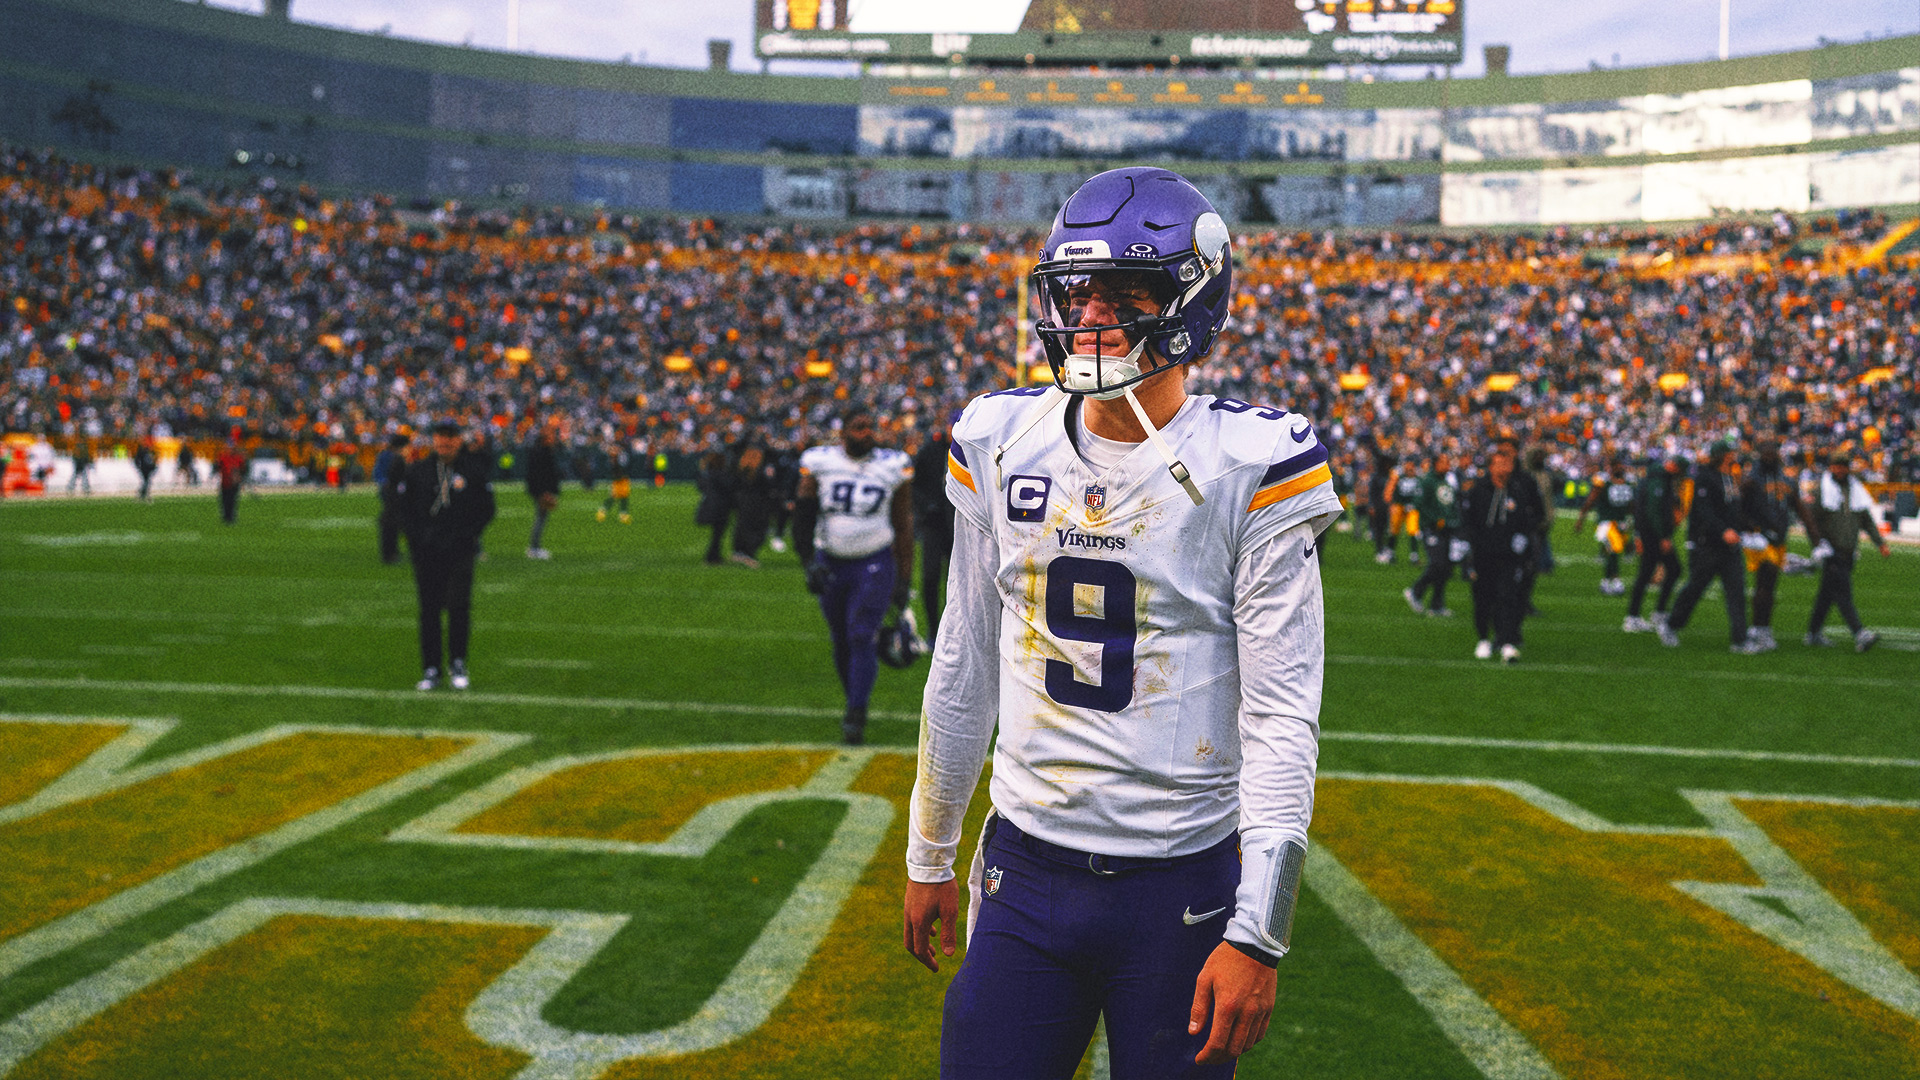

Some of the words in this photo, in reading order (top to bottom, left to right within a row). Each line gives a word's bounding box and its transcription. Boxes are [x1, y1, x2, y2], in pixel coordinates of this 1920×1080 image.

[1190, 35, 1312, 56] ticketmaster
[1124, 251, 1157, 259] OAKLEY
[831, 481, 886, 517] 97
[1010, 478, 1046, 510] C
[1086, 493, 1104, 507] NFL
[1056, 524, 1127, 552] Vikings
[1044, 554, 1138, 714] 9
